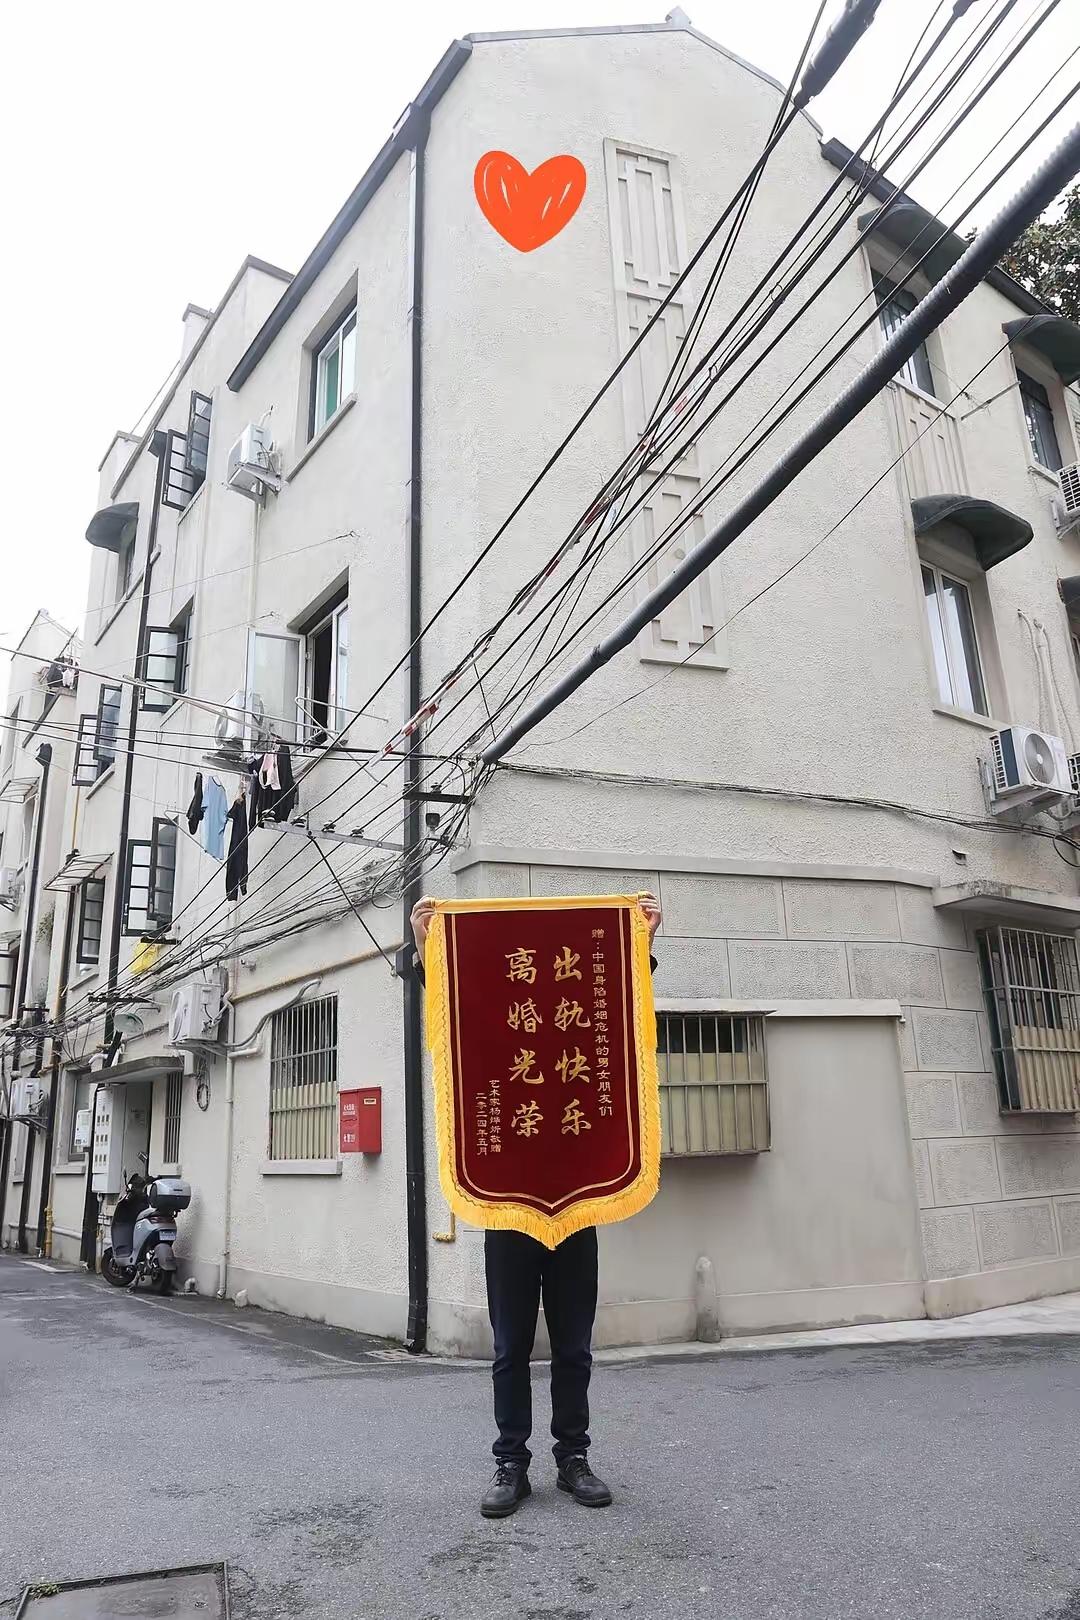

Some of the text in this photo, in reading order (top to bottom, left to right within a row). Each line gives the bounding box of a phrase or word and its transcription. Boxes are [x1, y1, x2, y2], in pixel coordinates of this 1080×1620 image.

[475, 1092, 489, 1156] 二零二四年五月
[505, 948, 544, 1138] 离婚光荣
[554, 947, 592, 1136] 出轨快乐
